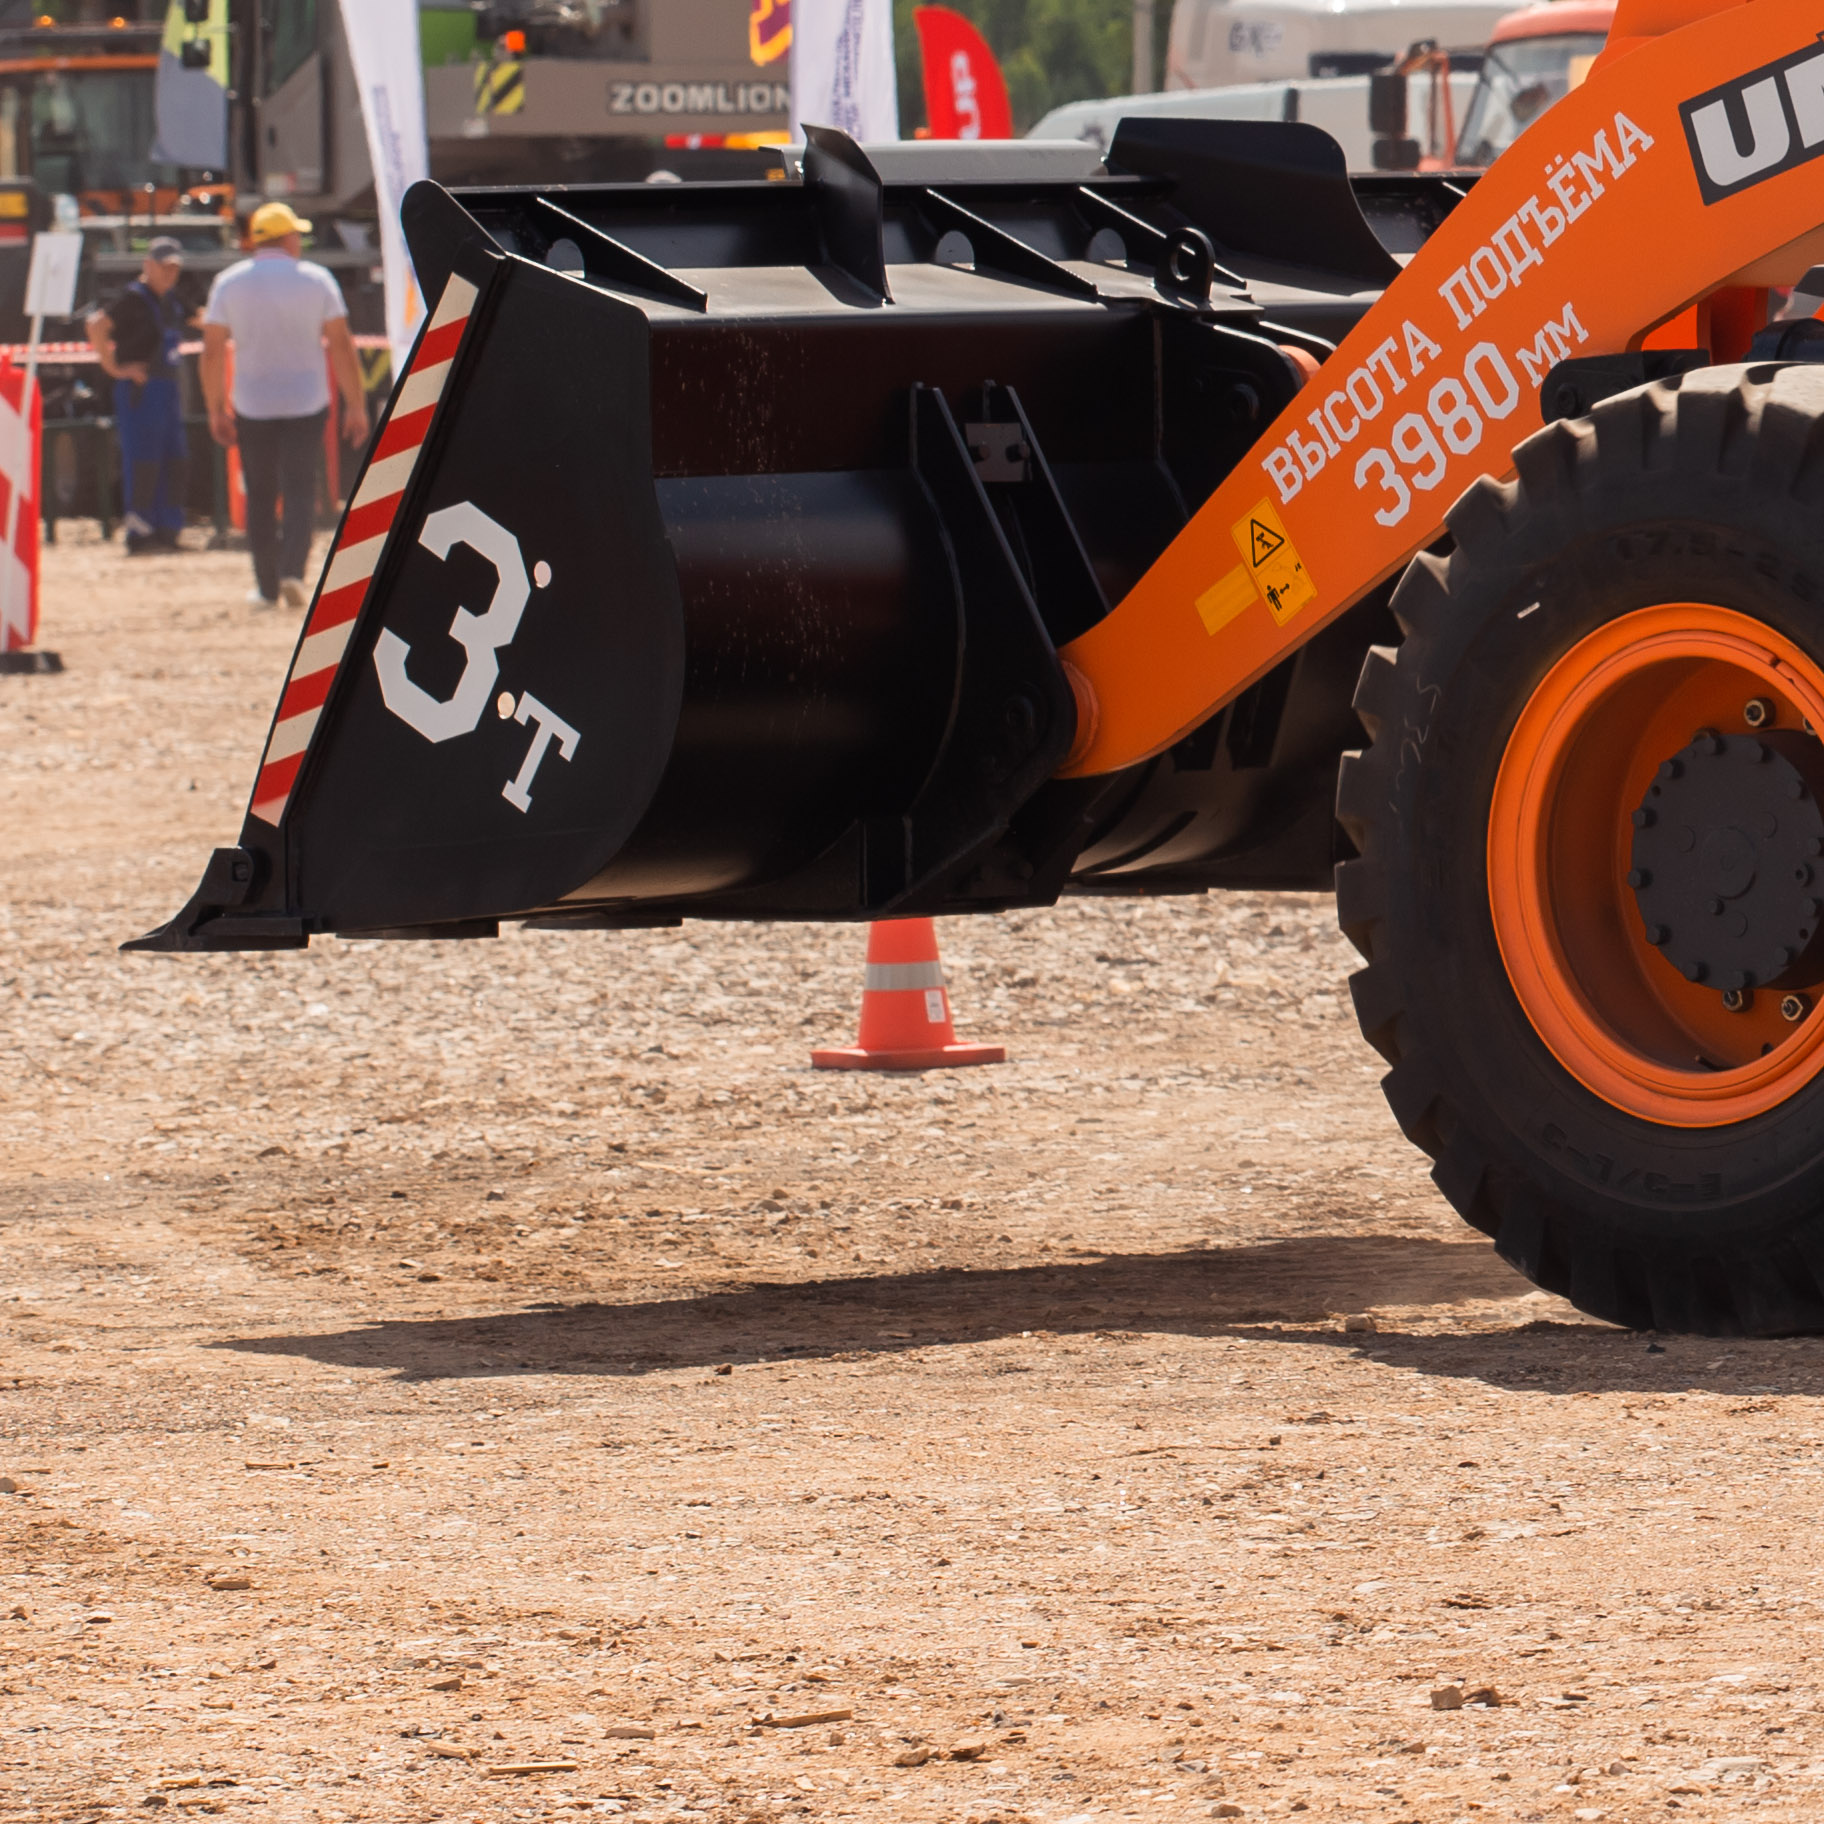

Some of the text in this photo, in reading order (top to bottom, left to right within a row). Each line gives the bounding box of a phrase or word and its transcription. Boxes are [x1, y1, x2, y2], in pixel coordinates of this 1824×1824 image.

[609, 81, 791, 114] ZOOMLION
[1260, 110, 1656, 506] ВЫСОТА ПОДЪЁМА
[1354, 340, 1522, 528] 3980
[371, 500, 531, 746] 3
